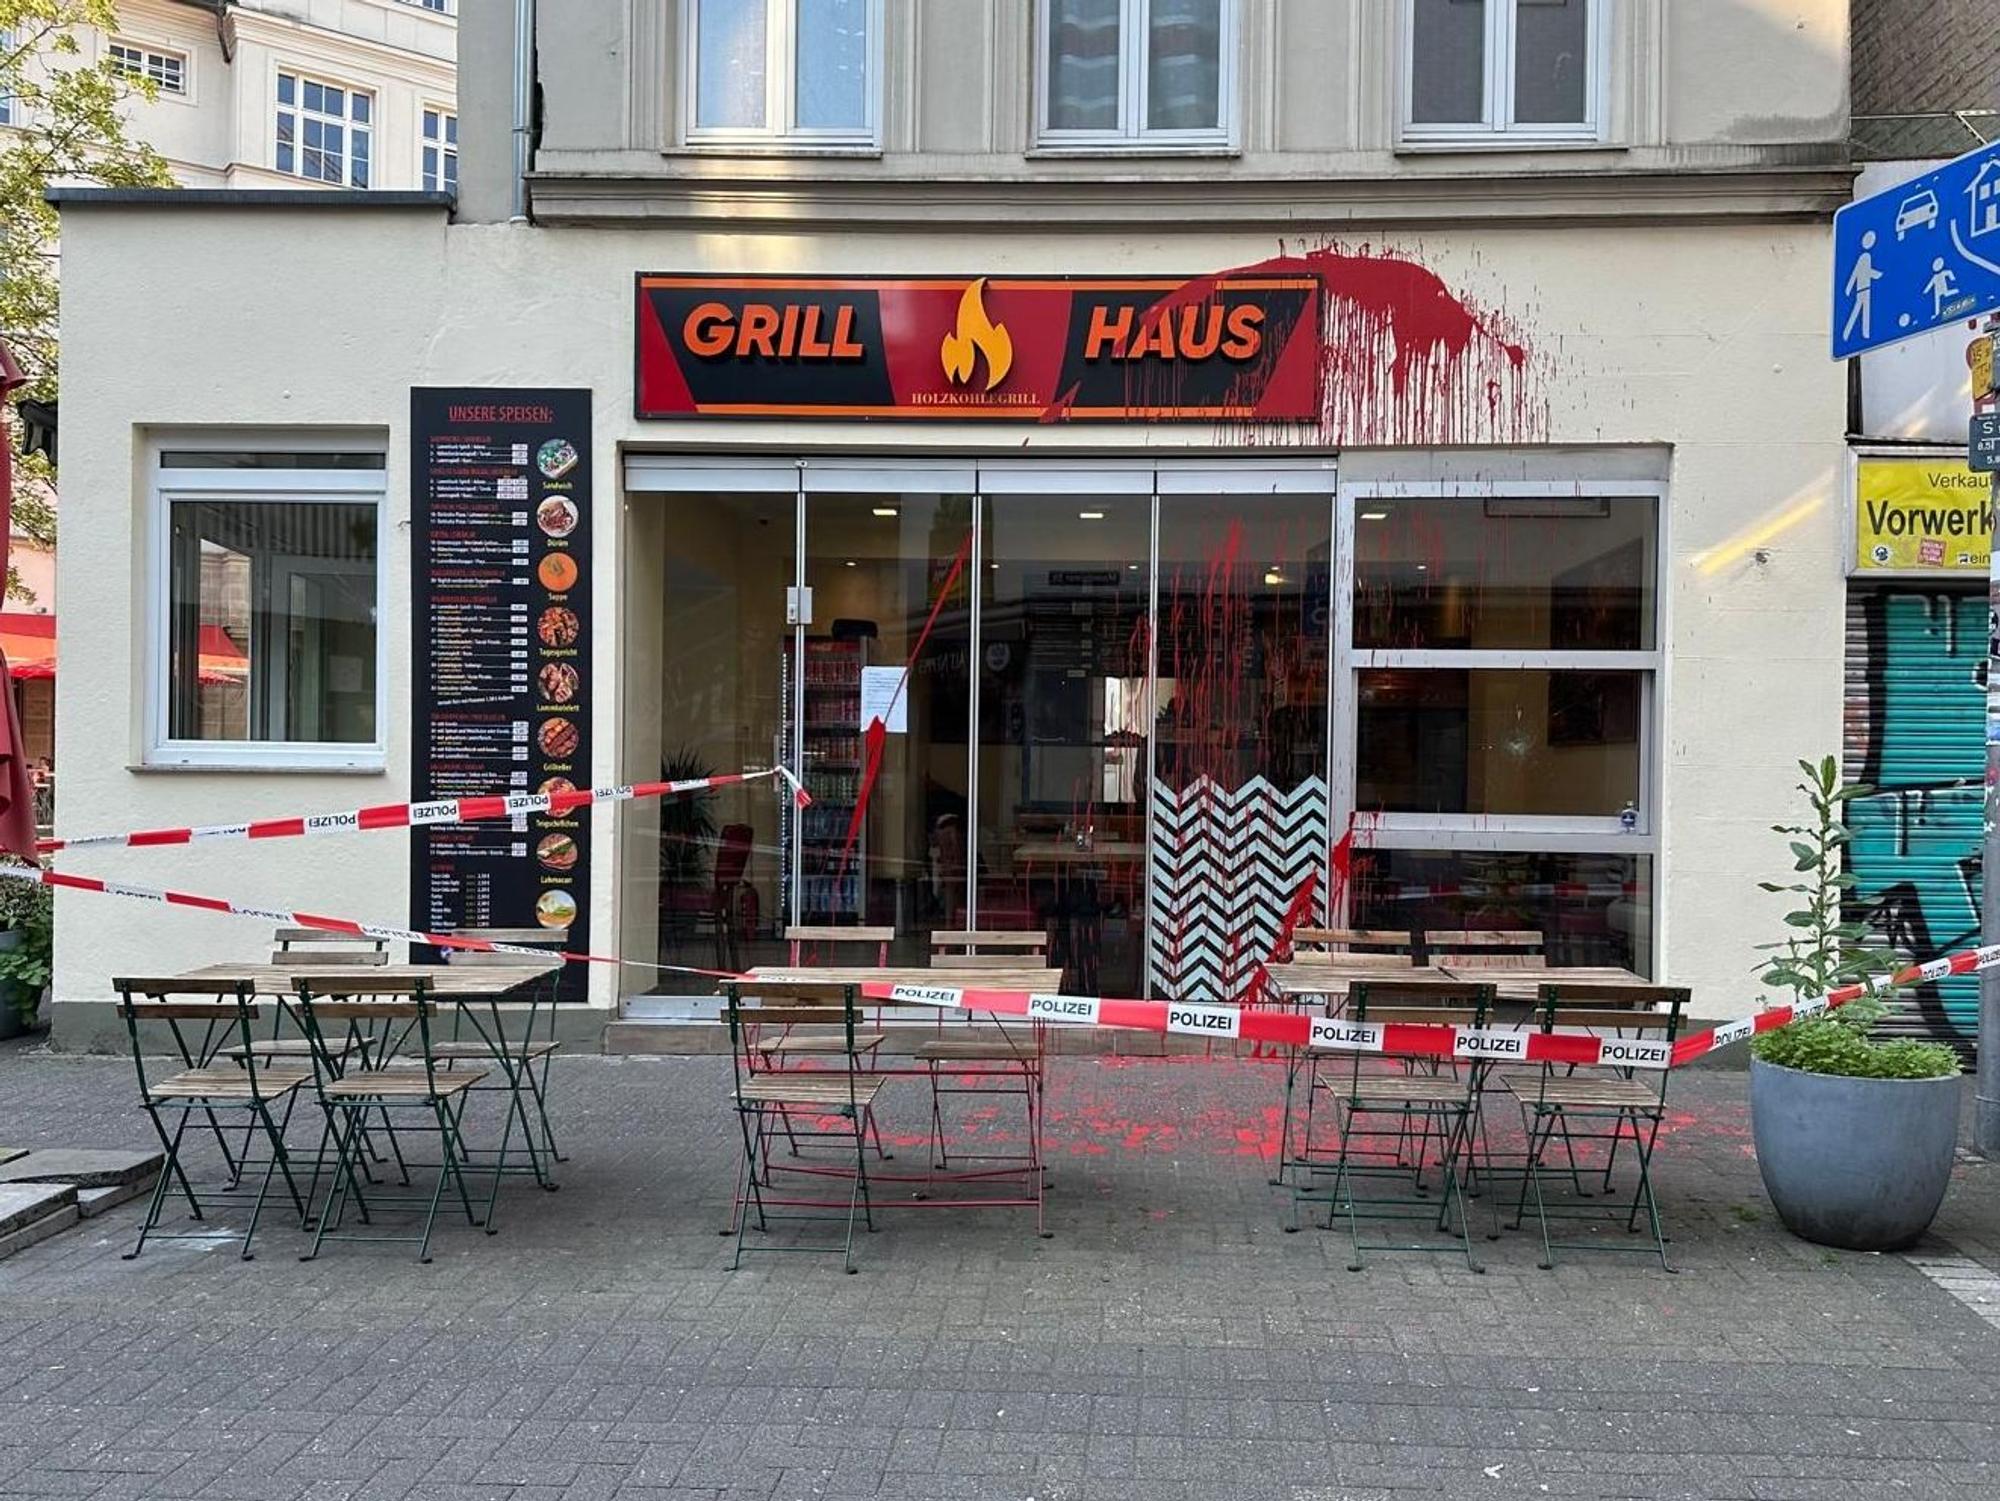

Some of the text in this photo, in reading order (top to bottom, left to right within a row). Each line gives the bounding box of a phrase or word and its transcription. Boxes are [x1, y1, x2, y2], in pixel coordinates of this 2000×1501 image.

[683, 303, 866, 360] GRILL
[1084, 304, 1265, 361] HAUS
[911, 392, 1041, 405] HOLZKOHLEGRILL
[449, 405, 496, 421] UNSERE
[1928, 472, 1991, 489] Verkau
[1867, 500, 1995, 537] Vorwerk
[508, 796, 549, 808] POLIZEI
[413, 804, 457, 818] POLIZEI
[308, 814, 356, 827] POLIZEI
[895, 987, 955, 1001] POLIZEI
[1031, 999, 1093, 1016] POLIZEI
[1169, 1011, 1232, 1030] POLIZEI
[1312, 1026, 1376, 1044] POLIZEI
[1457, 1036, 1521, 1053] POLIZEI
[1602, 1045, 1666, 1061] POLIZEI
